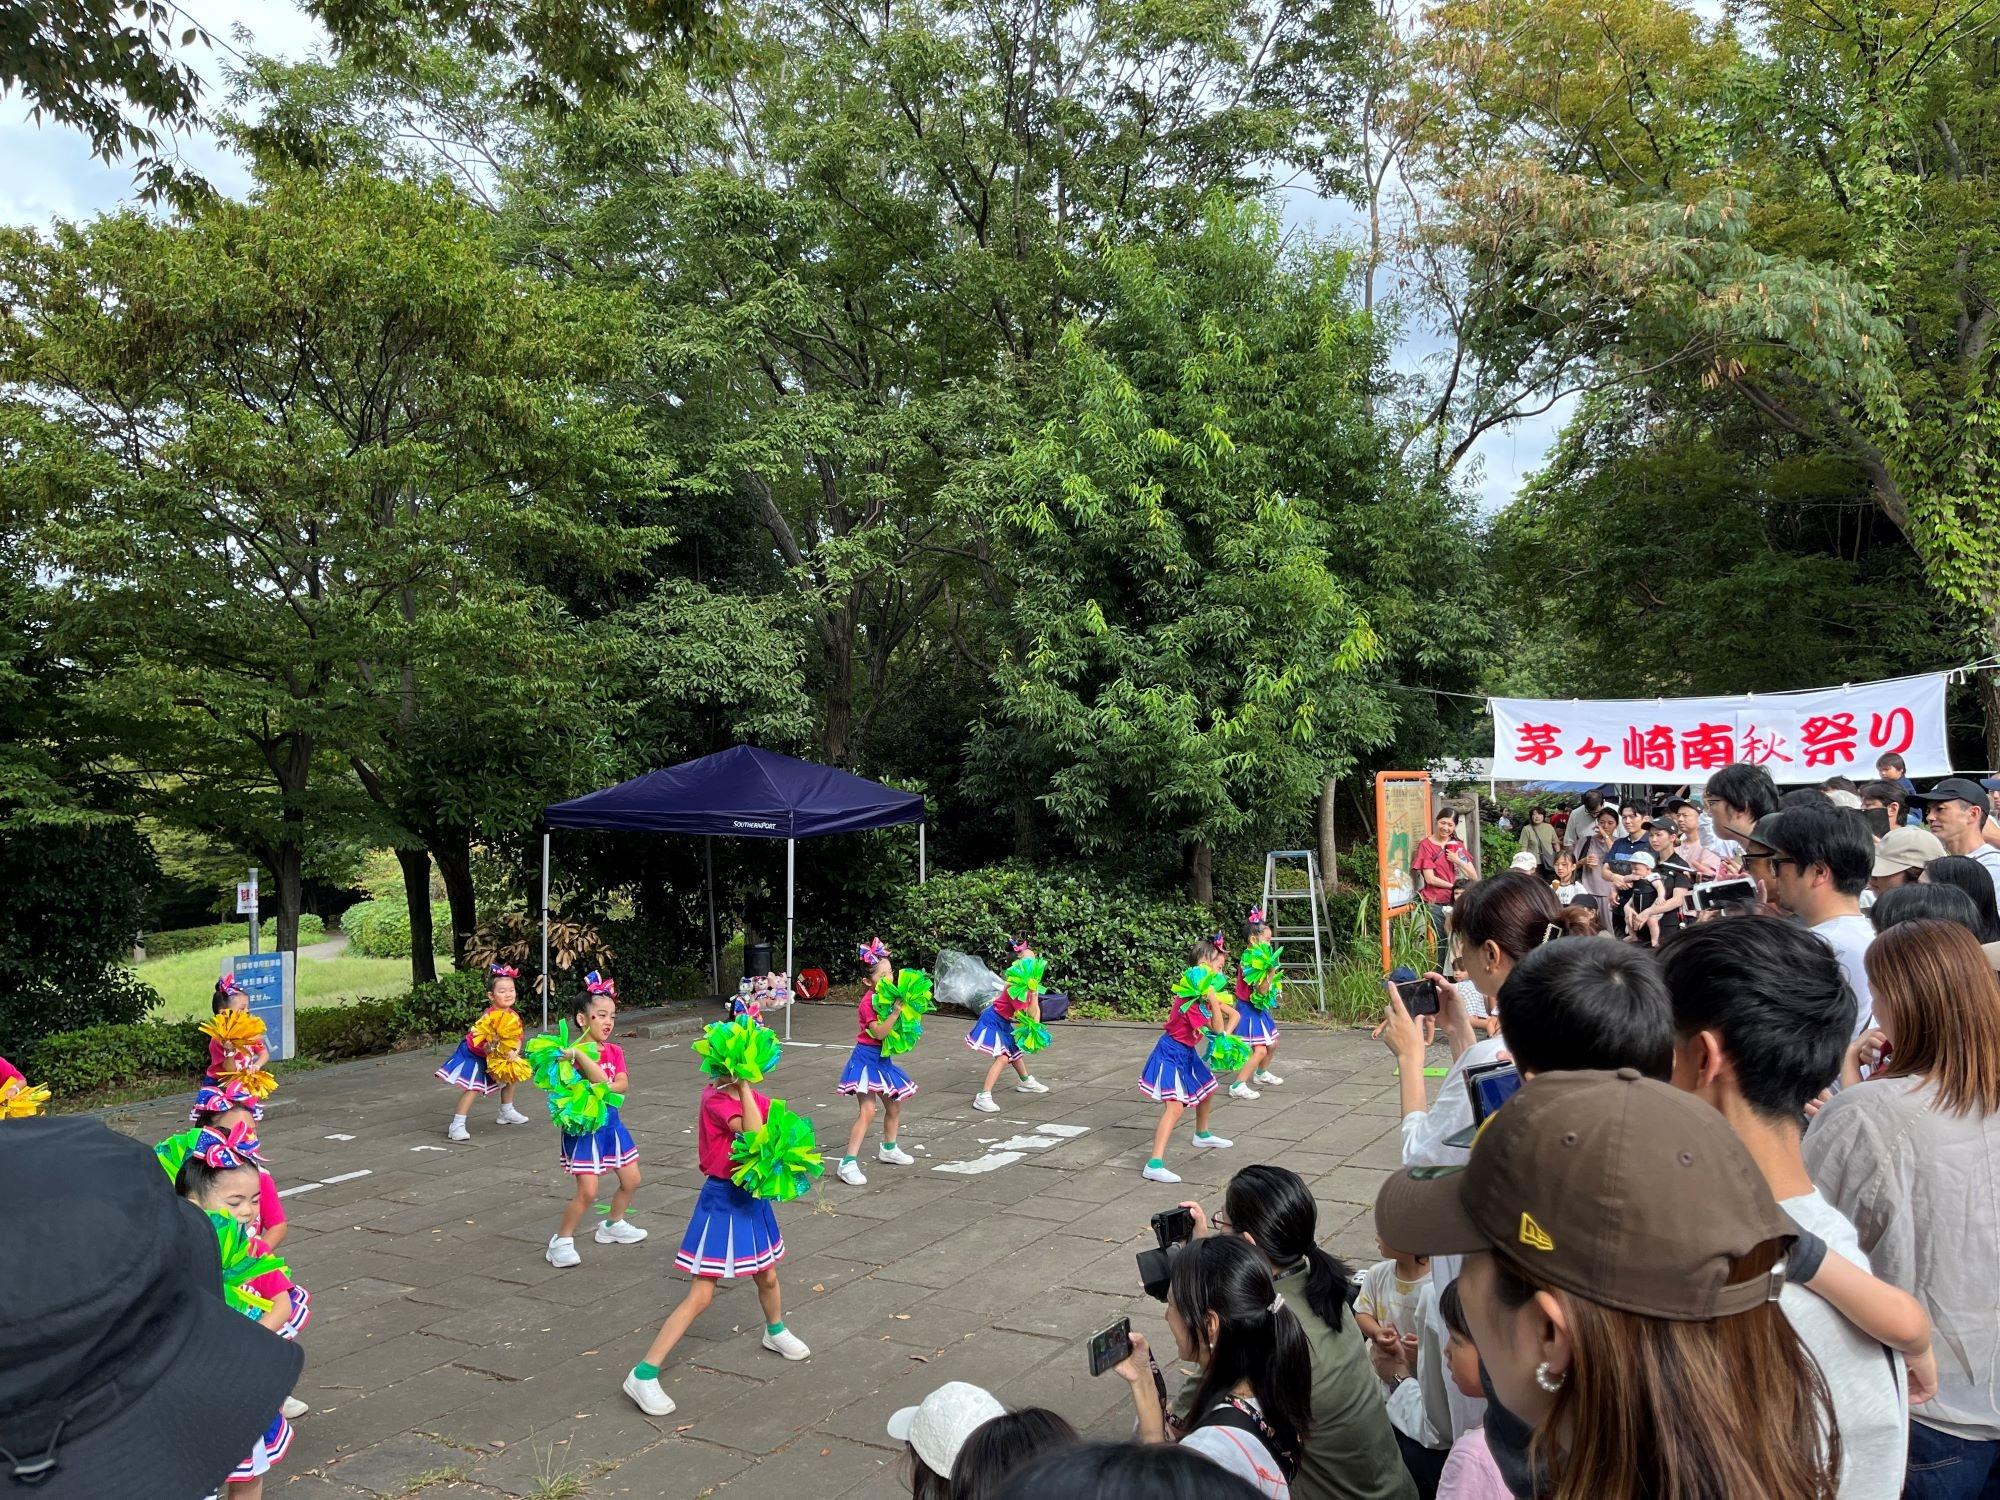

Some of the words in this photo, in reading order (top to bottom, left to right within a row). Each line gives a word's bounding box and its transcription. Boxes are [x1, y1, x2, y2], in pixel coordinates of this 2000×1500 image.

[1515, 706, 1914, 771] 茅ヶ崎南秋祭り
